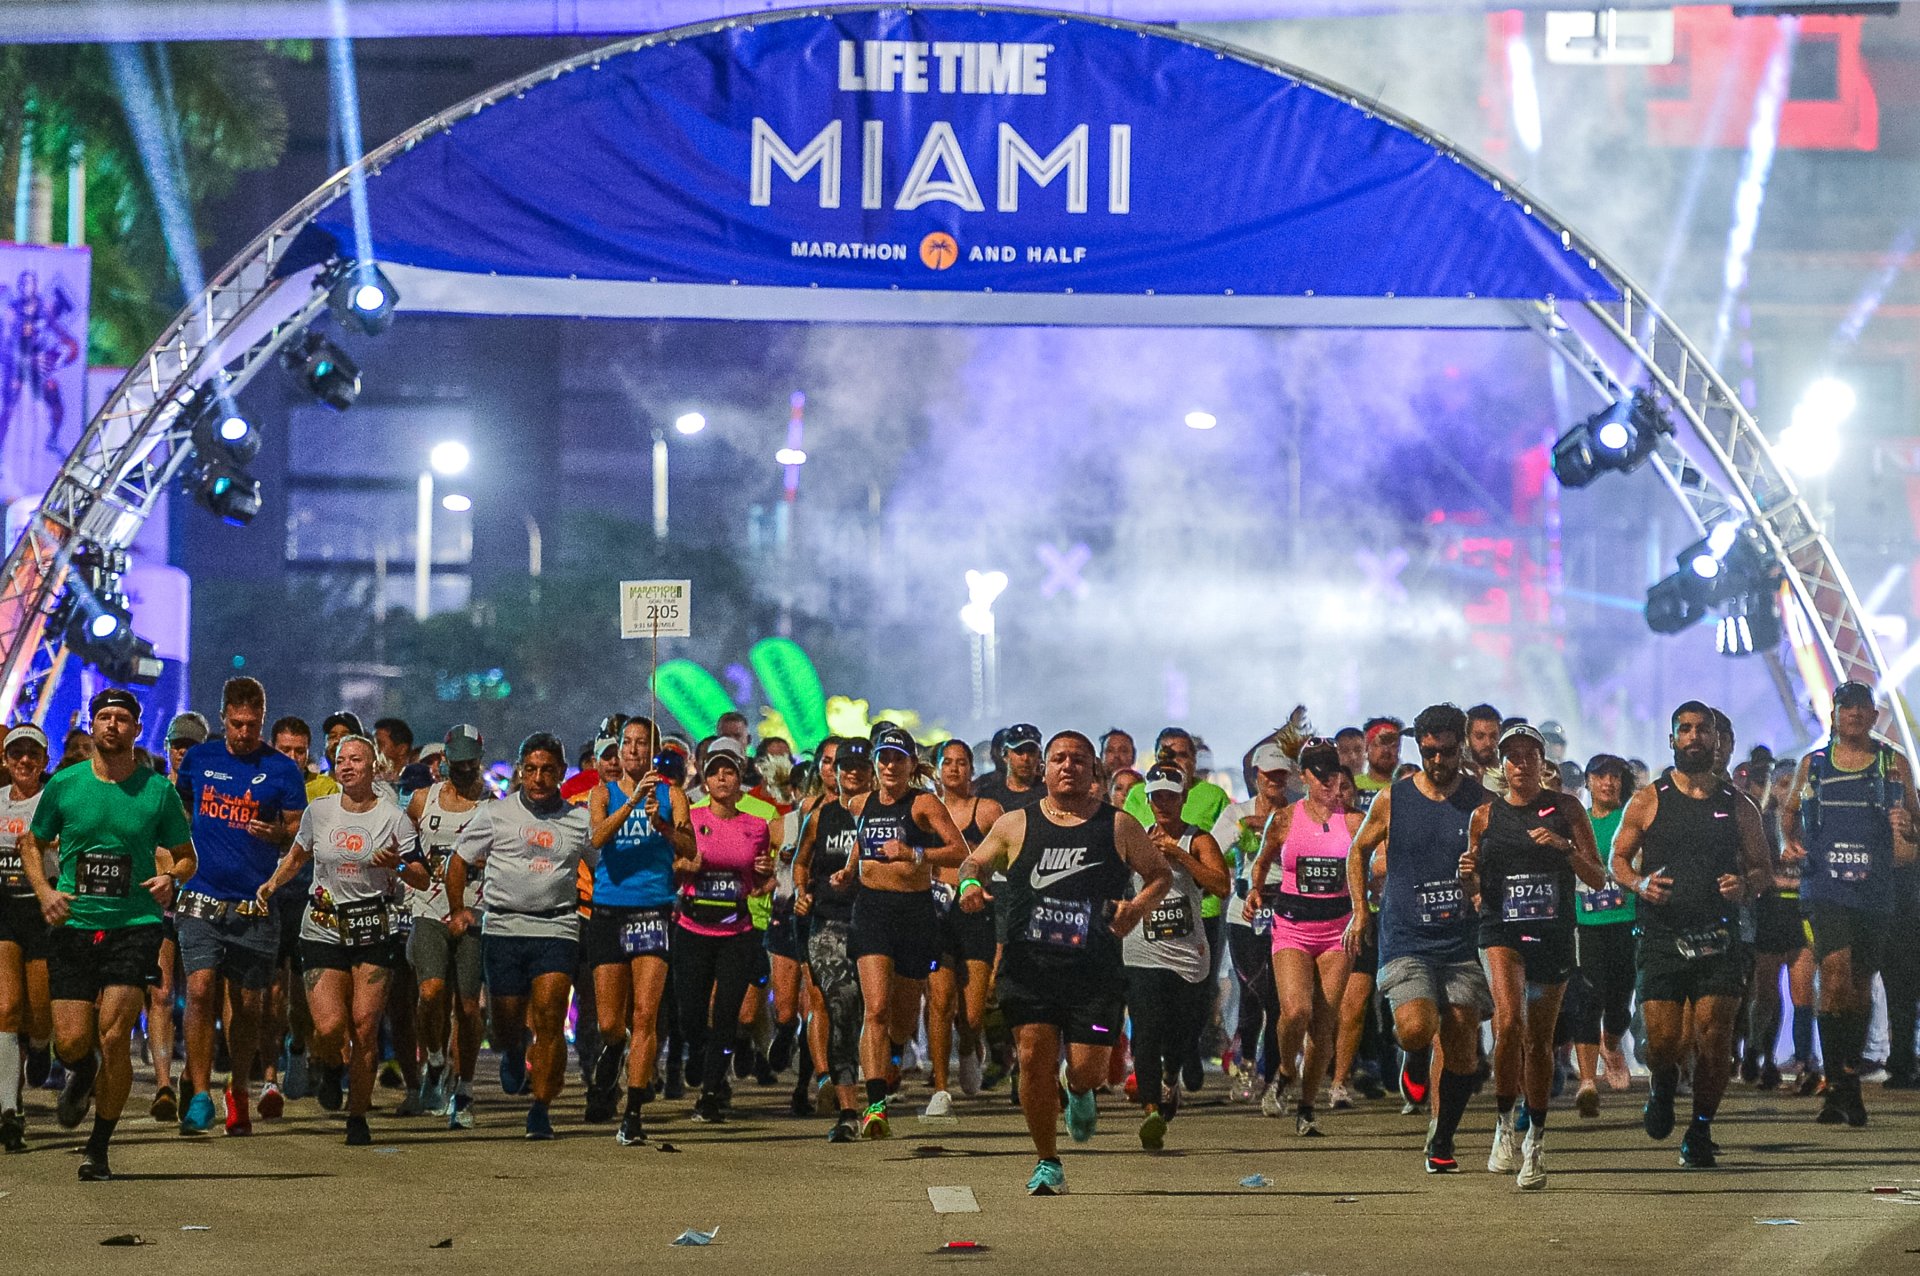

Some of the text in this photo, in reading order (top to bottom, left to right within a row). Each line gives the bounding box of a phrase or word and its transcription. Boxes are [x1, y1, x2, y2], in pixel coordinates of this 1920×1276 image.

[750, 116, 1132, 214] MIAMI
[791, 240, 1087, 264] MARATHON AND HALF
[629, 586, 677, 594] MARATHON
[646, 604, 679, 619] 2:05
[865, 827, 898, 839] 17531
[1038, 847, 1088, 870] NIKE
[1827, 851, 1869, 864] 22958
[85, 863, 119, 877] 1428
[1305, 866, 1337, 877] 3853
[1421, 889, 1463, 904] 13330
[1507, 883, 1553, 898] 19743
[348, 914, 380, 929] 3486
[1035, 906, 1084, 926] 23096
[1150, 908, 1184, 922] 3968
[626, 920, 663, 935] 22145
